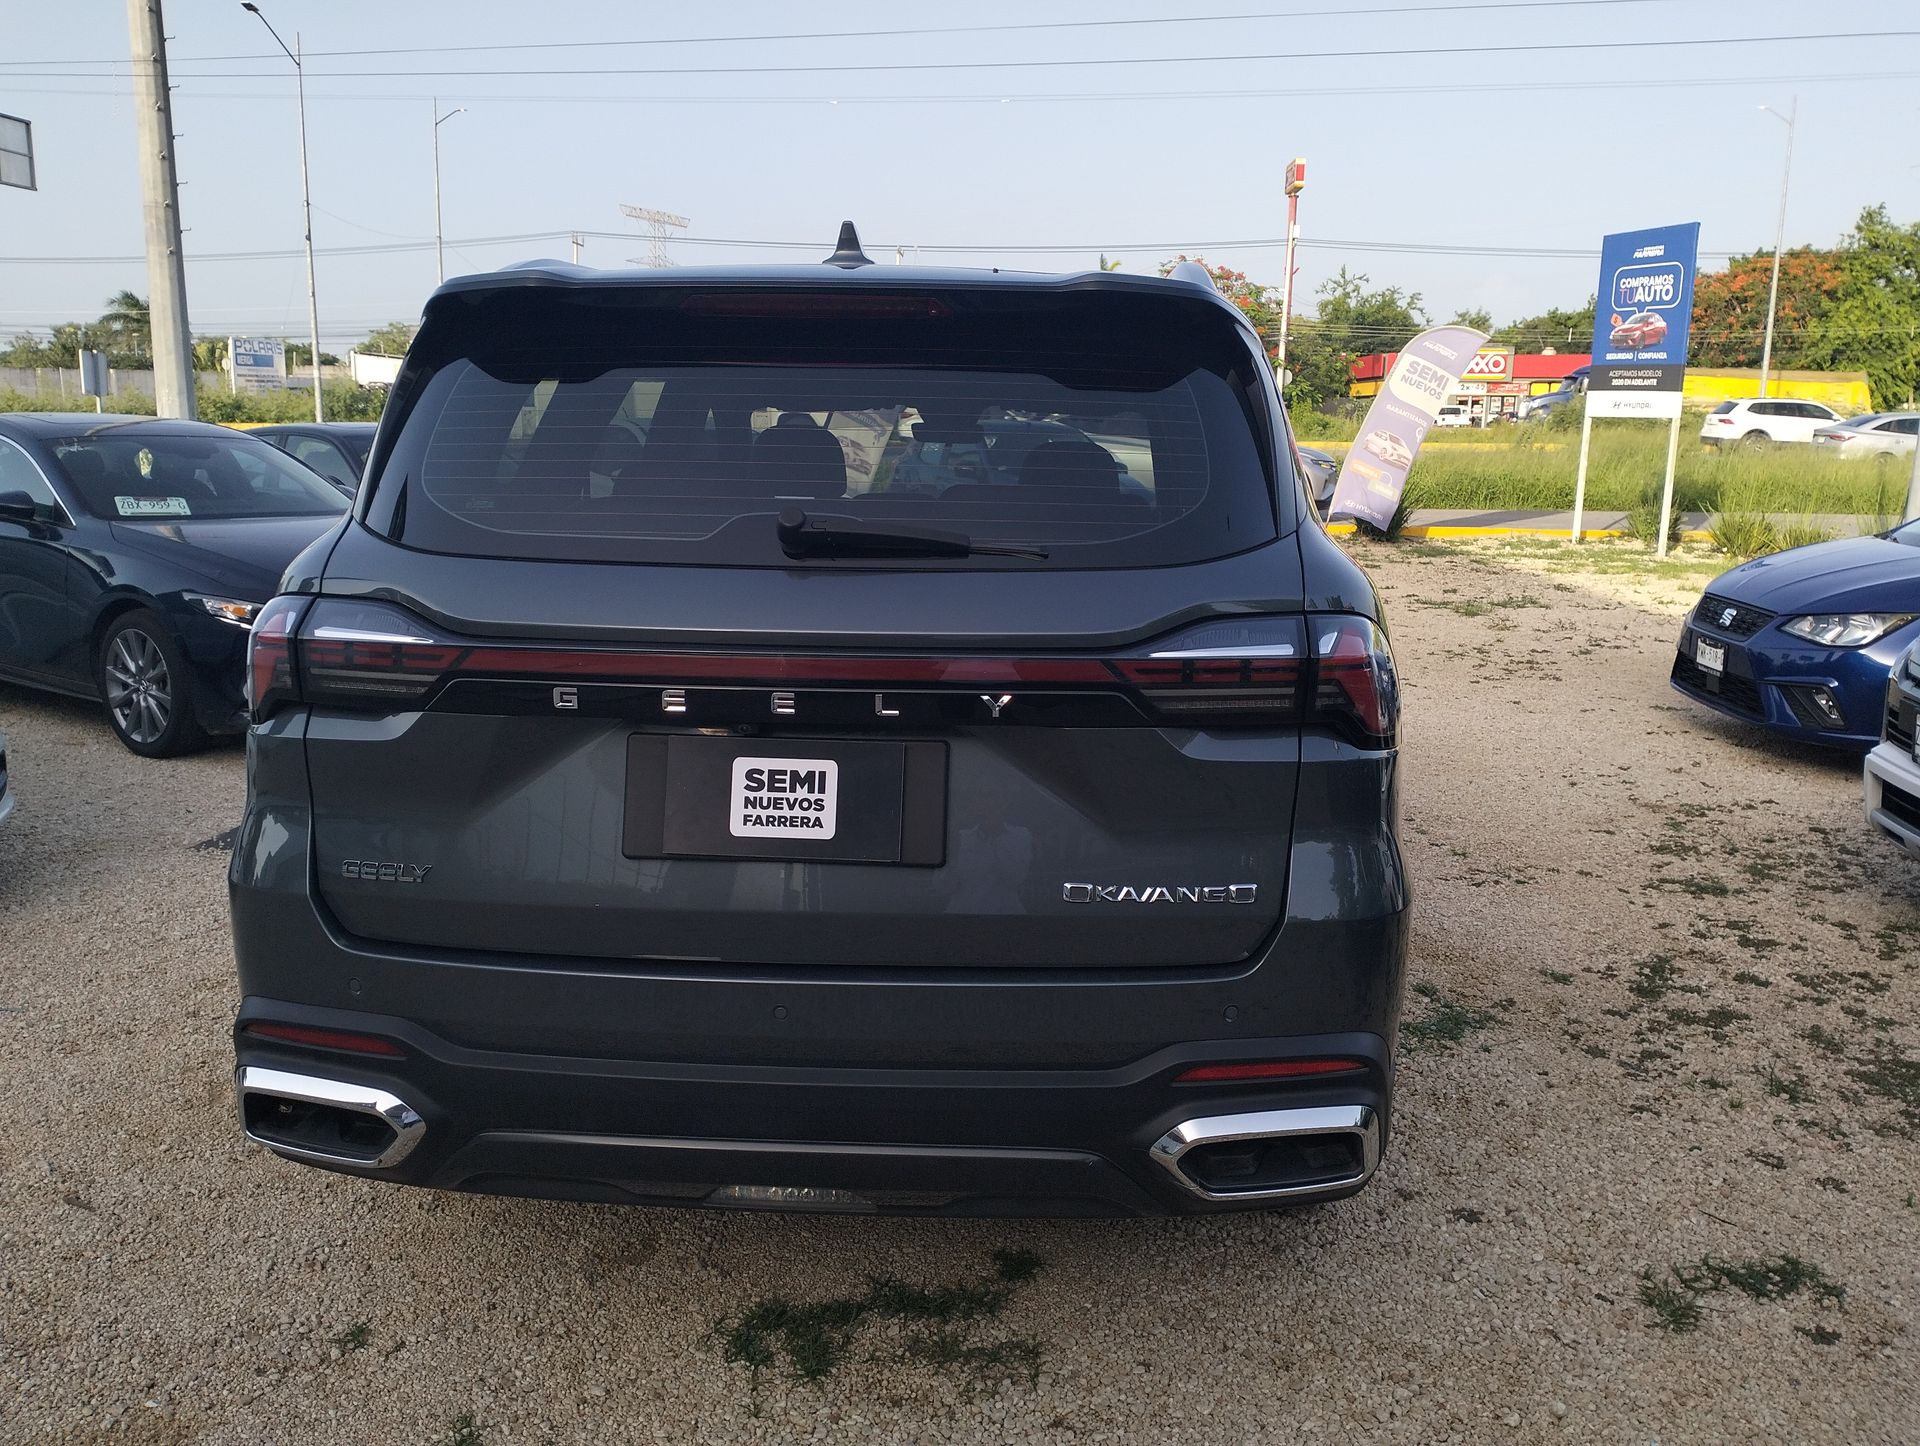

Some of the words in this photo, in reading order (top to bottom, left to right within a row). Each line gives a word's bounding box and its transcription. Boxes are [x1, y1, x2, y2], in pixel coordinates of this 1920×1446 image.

[1620, 274, 1674, 289] COMPRAMOS
[1619, 288, 1635, 304] TU
[1634, 284, 1673, 303] AUTO
[234, 339, 283, 355] POLARIS
[1465, 353, 1505, 373] XXO
[1406, 360, 1449, 391] SEMI
[1400, 374, 1443, 400] NUEVOS
[553, 687, 1012, 718] GEELY
[744, 768, 827, 794] SEMI
[744, 796, 825, 812] NUEVOS
[743, 814, 824, 828] FARRERA
[341, 860, 432, 883] GEELY
[1063, 882, 1257, 904] OKAVANGO
